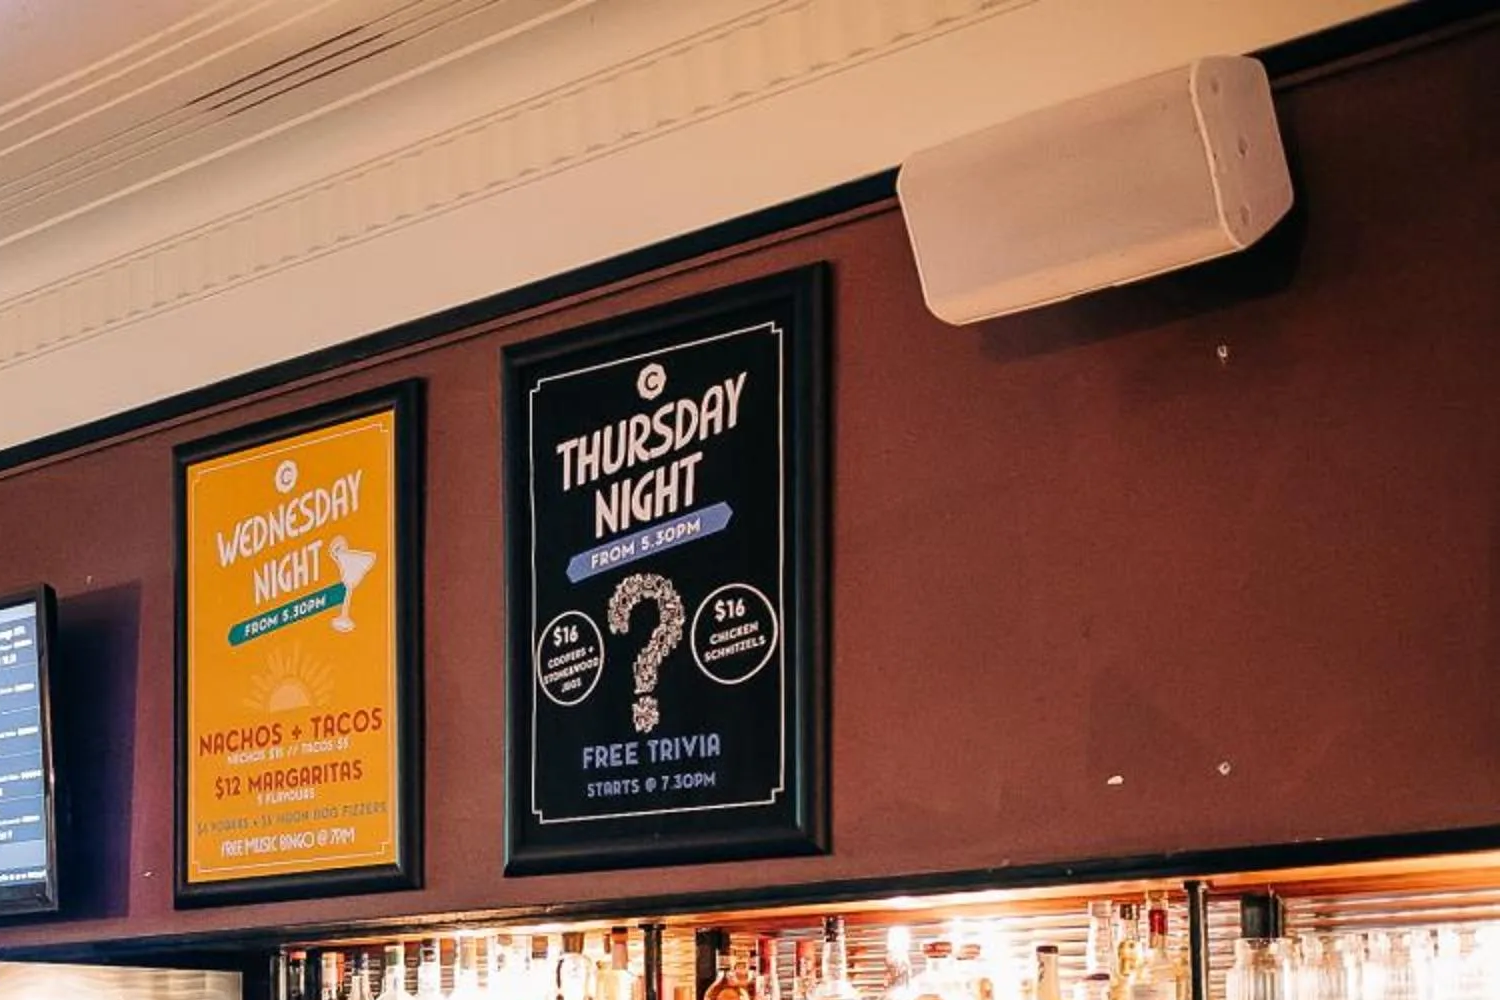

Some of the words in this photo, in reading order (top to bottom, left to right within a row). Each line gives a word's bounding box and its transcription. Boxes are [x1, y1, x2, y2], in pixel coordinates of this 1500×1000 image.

[556, 371, 747, 491] THURSDAY
[596, 451, 703, 539] NIGHT
[217, 469, 363, 568] WEDNESDAY
[591, 543, 635, 569] FROM
[641, 518, 701, 551] 5.30PM
[253, 540, 324, 605] NIGHT
[244, 616, 279, 638] FROM
[282, 596, 327, 622] 5.30PM
[714, 597, 746, 622] $16
[553, 624, 579, 647] $16
[709, 620, 760, 645] CHICKEN
[200, 723, 282, 756] NACHOS
[291, 725, 302, 741] +
[311, 707, 383, 740] TACOS
[583, 741, 639, 770] FREE
[647, 733, 721, 763] TRIVIA
[215, 776, 241, 801] $12
[248, 759, 363, 793] MARGARITAS
[587, 778, 640, 798] STARTS
[645, 776, 657, 793] @
[661, 772, 717, 790] 7.30PM
